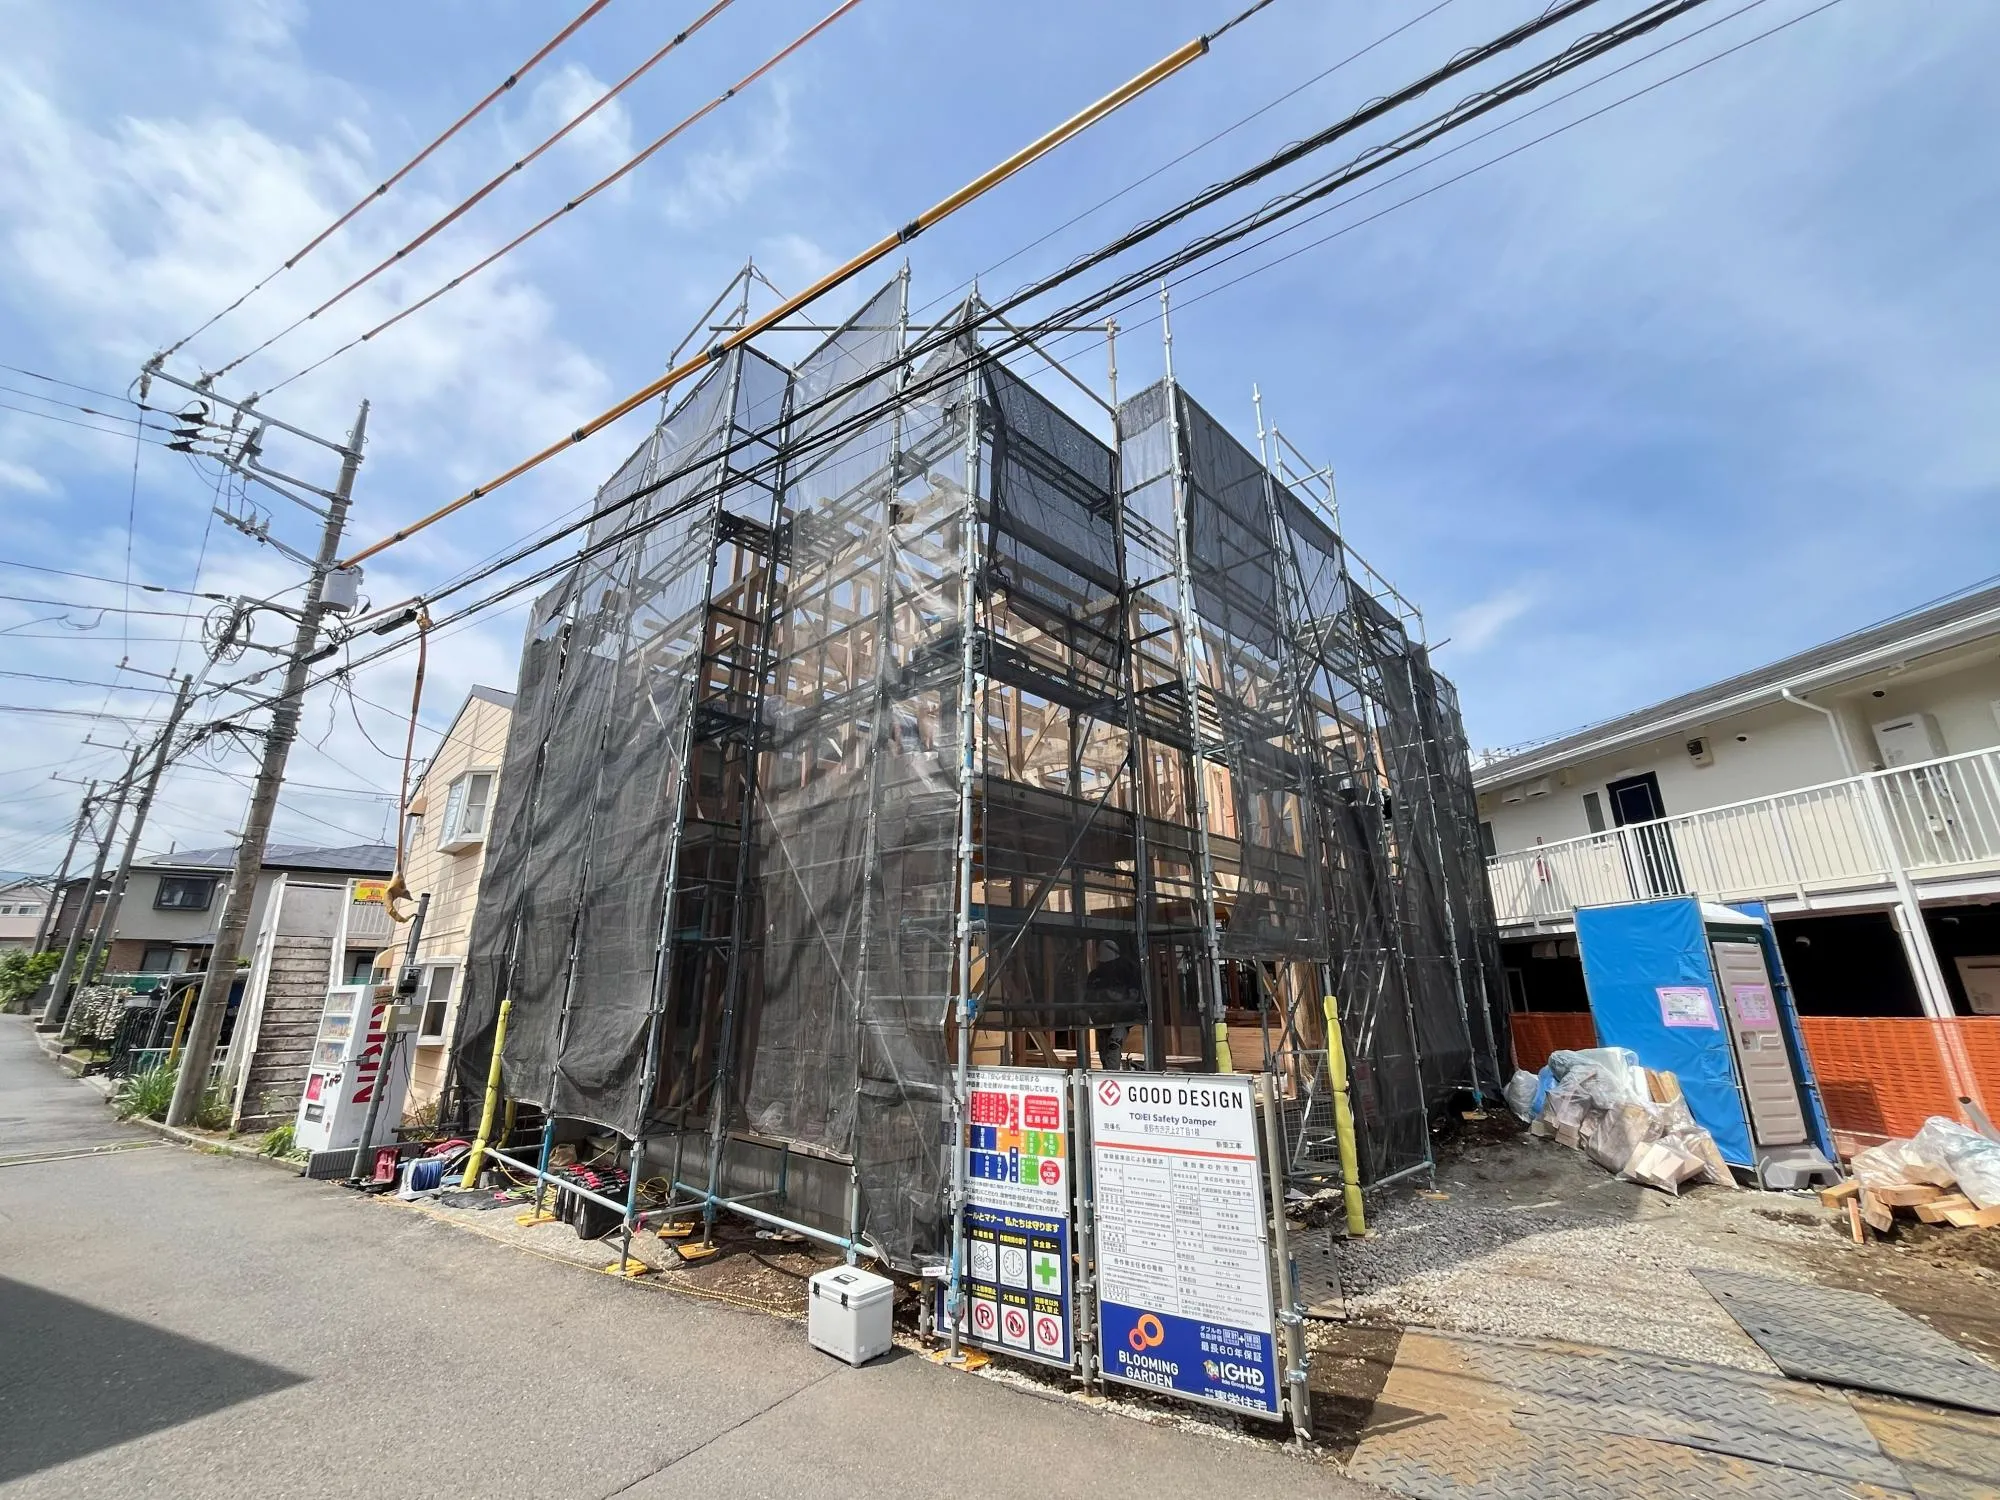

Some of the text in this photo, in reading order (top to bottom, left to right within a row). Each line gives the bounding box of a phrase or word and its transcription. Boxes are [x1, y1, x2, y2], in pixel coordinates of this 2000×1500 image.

[352, 1005, 391, 1103] IRIN
[1128, 1086, 1243, 1109] GOOD DESIGN
[1153, 1114, 1179, 1126] Safety
[1182, 1116, 1217, 1128] Damper
[1004, 1216, 1060, 1233] 私たちは守ります
[1033, 1240, 1058, 1249] 安全第一
[1035, 1303, 1059, 1315] 立入禁止
[1200, 1325, 1222, 1335] ダブルの
[1118, 1350, 1179, 1376] BLOOMING
[1201, 1341, 1263, 1363] 最長60年保証
[1126, 1366, 1173, 1388] GARDEN
[1219, 1361, 1265, 1387] IGHD
[1214, 1389, 1268, 1411] 東栄住宅
